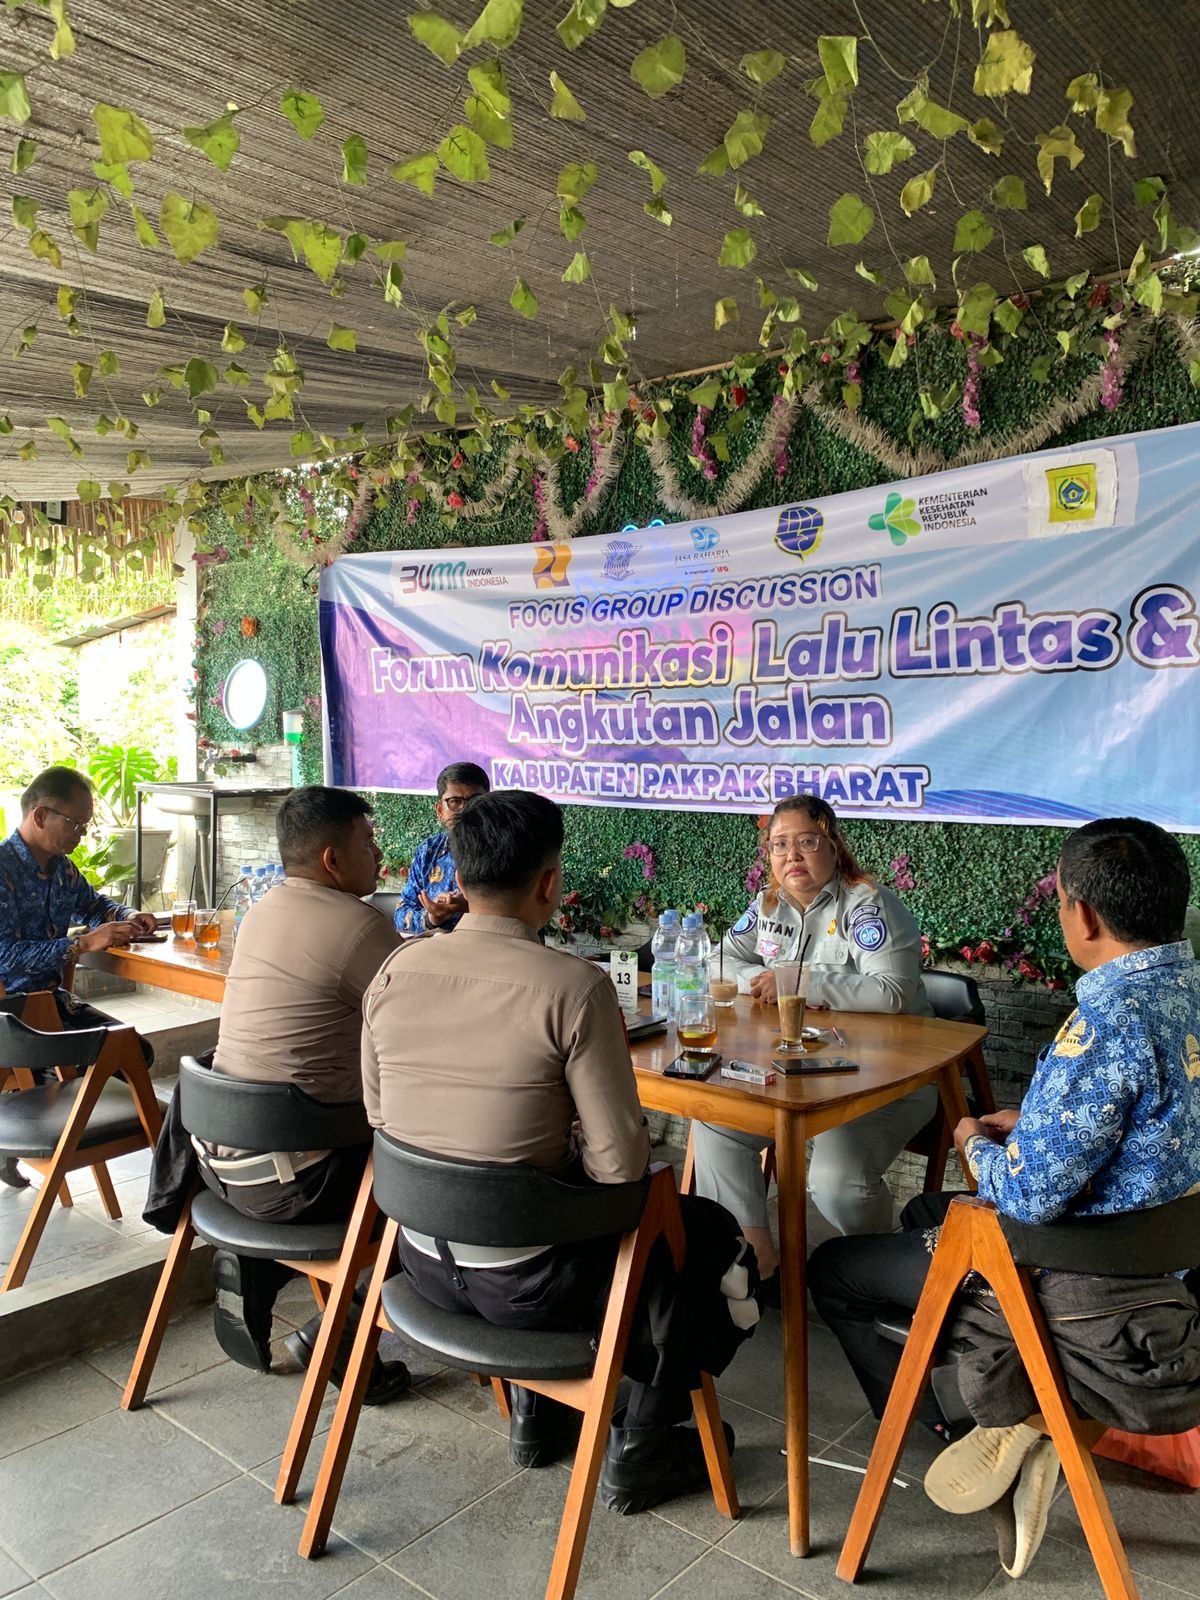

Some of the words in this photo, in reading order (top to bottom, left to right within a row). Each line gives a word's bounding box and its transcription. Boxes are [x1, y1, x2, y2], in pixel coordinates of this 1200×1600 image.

[919, 488, 988, 506] KEMENTERIAN
[919, 499, 975, 515] KESEHATAN
[922, 509, 968, 523] REPUBLIK
[924, 517, 977, 532] INDONESIA
[466, 568, 493, 577] UNTUK
[468, 576, 509, 588] INDONESIA
[510, 601, 585, 629] FOCUS
[591, 593, 684, 622] GROUP
[689, 569, 878, 614] DISCUSSION
[372, 650, 475, 691] Forum
[481, 628, 729, 691] Komunikasi
[756, 618, 877, 677] Lalu
[895, 608, 1114, 671] Lintas
[1136, 592, 1194, 660] &
[509, 694, 716, 753] Angkutan
[729, 686, 886, 741] Jalan
[493, 762, 636, 794] KABUPATEN
[642, 767, 768, 799] PAKPAK
[774, 768, 924, 803] BHARAT
[758, 919, 795, 938] INTAN
[616, 971, 631, 985] 13
